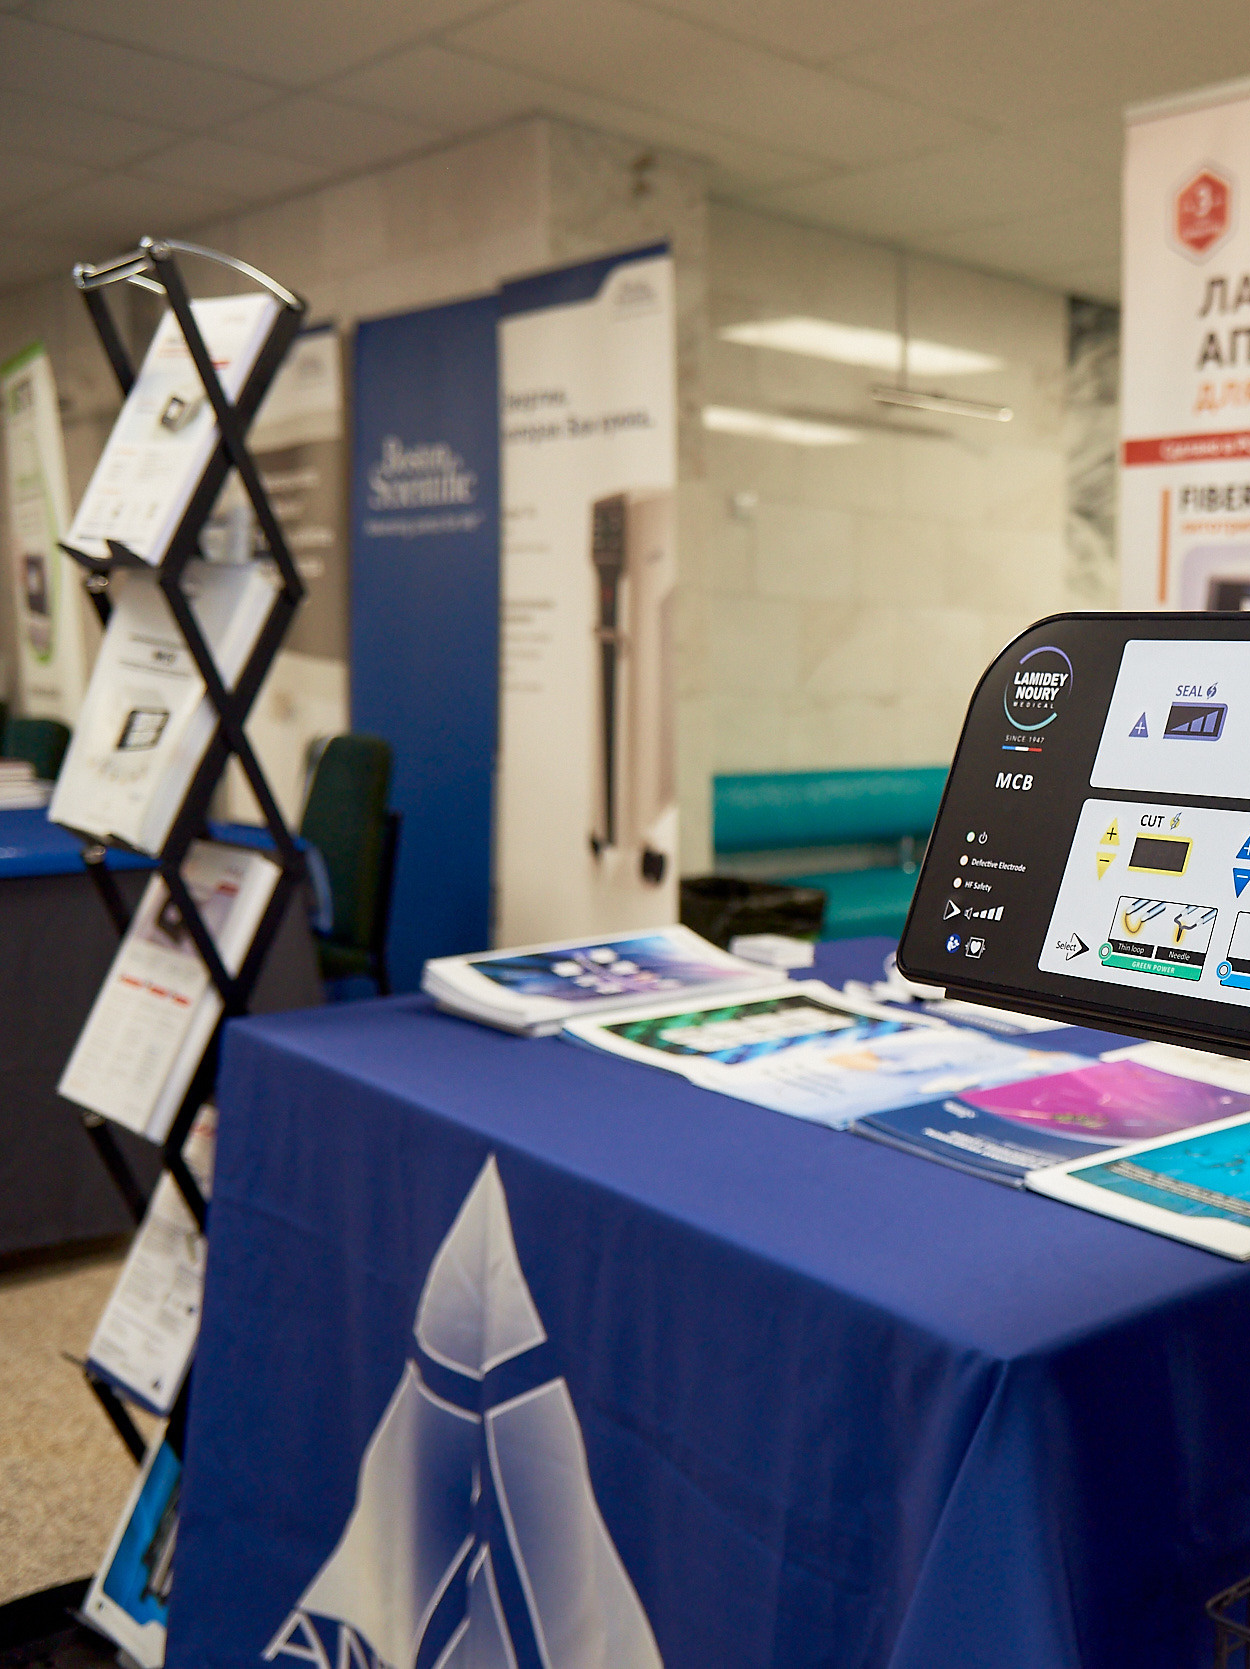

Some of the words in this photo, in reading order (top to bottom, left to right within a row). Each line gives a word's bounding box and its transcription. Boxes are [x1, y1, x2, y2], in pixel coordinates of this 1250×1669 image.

[1013, 671, 1069, 688] LAMIDEY
[1015, 685, 1060, 701] NOURY
[1175, 684, 1203, 697] SEAL
[1013, 701, 1055, 709] MEDICAL
[1005, 734, 1026, 743] SINCE
[1028, 736, 1045, 744] 1947
[995, 772, 1034, 791] MCB
[1140, 814, 1165, 828] CUT
[971, 858, 998, 870] Defective
[998, 862, 1026, 873] Electrode
[964, 881, 974, 890] HF
[974, 882, 993, 893] Safety
[1056, 941, 1077, 952] Select
[1117, 942, 1131, 953] Thin
[1131, 944, 1145, 956] loop
[1168, 950, 1191, 962] Needle
[1131, 960, 1152, 971] GREEN
[1153, 963, 1176, 975] POWER
